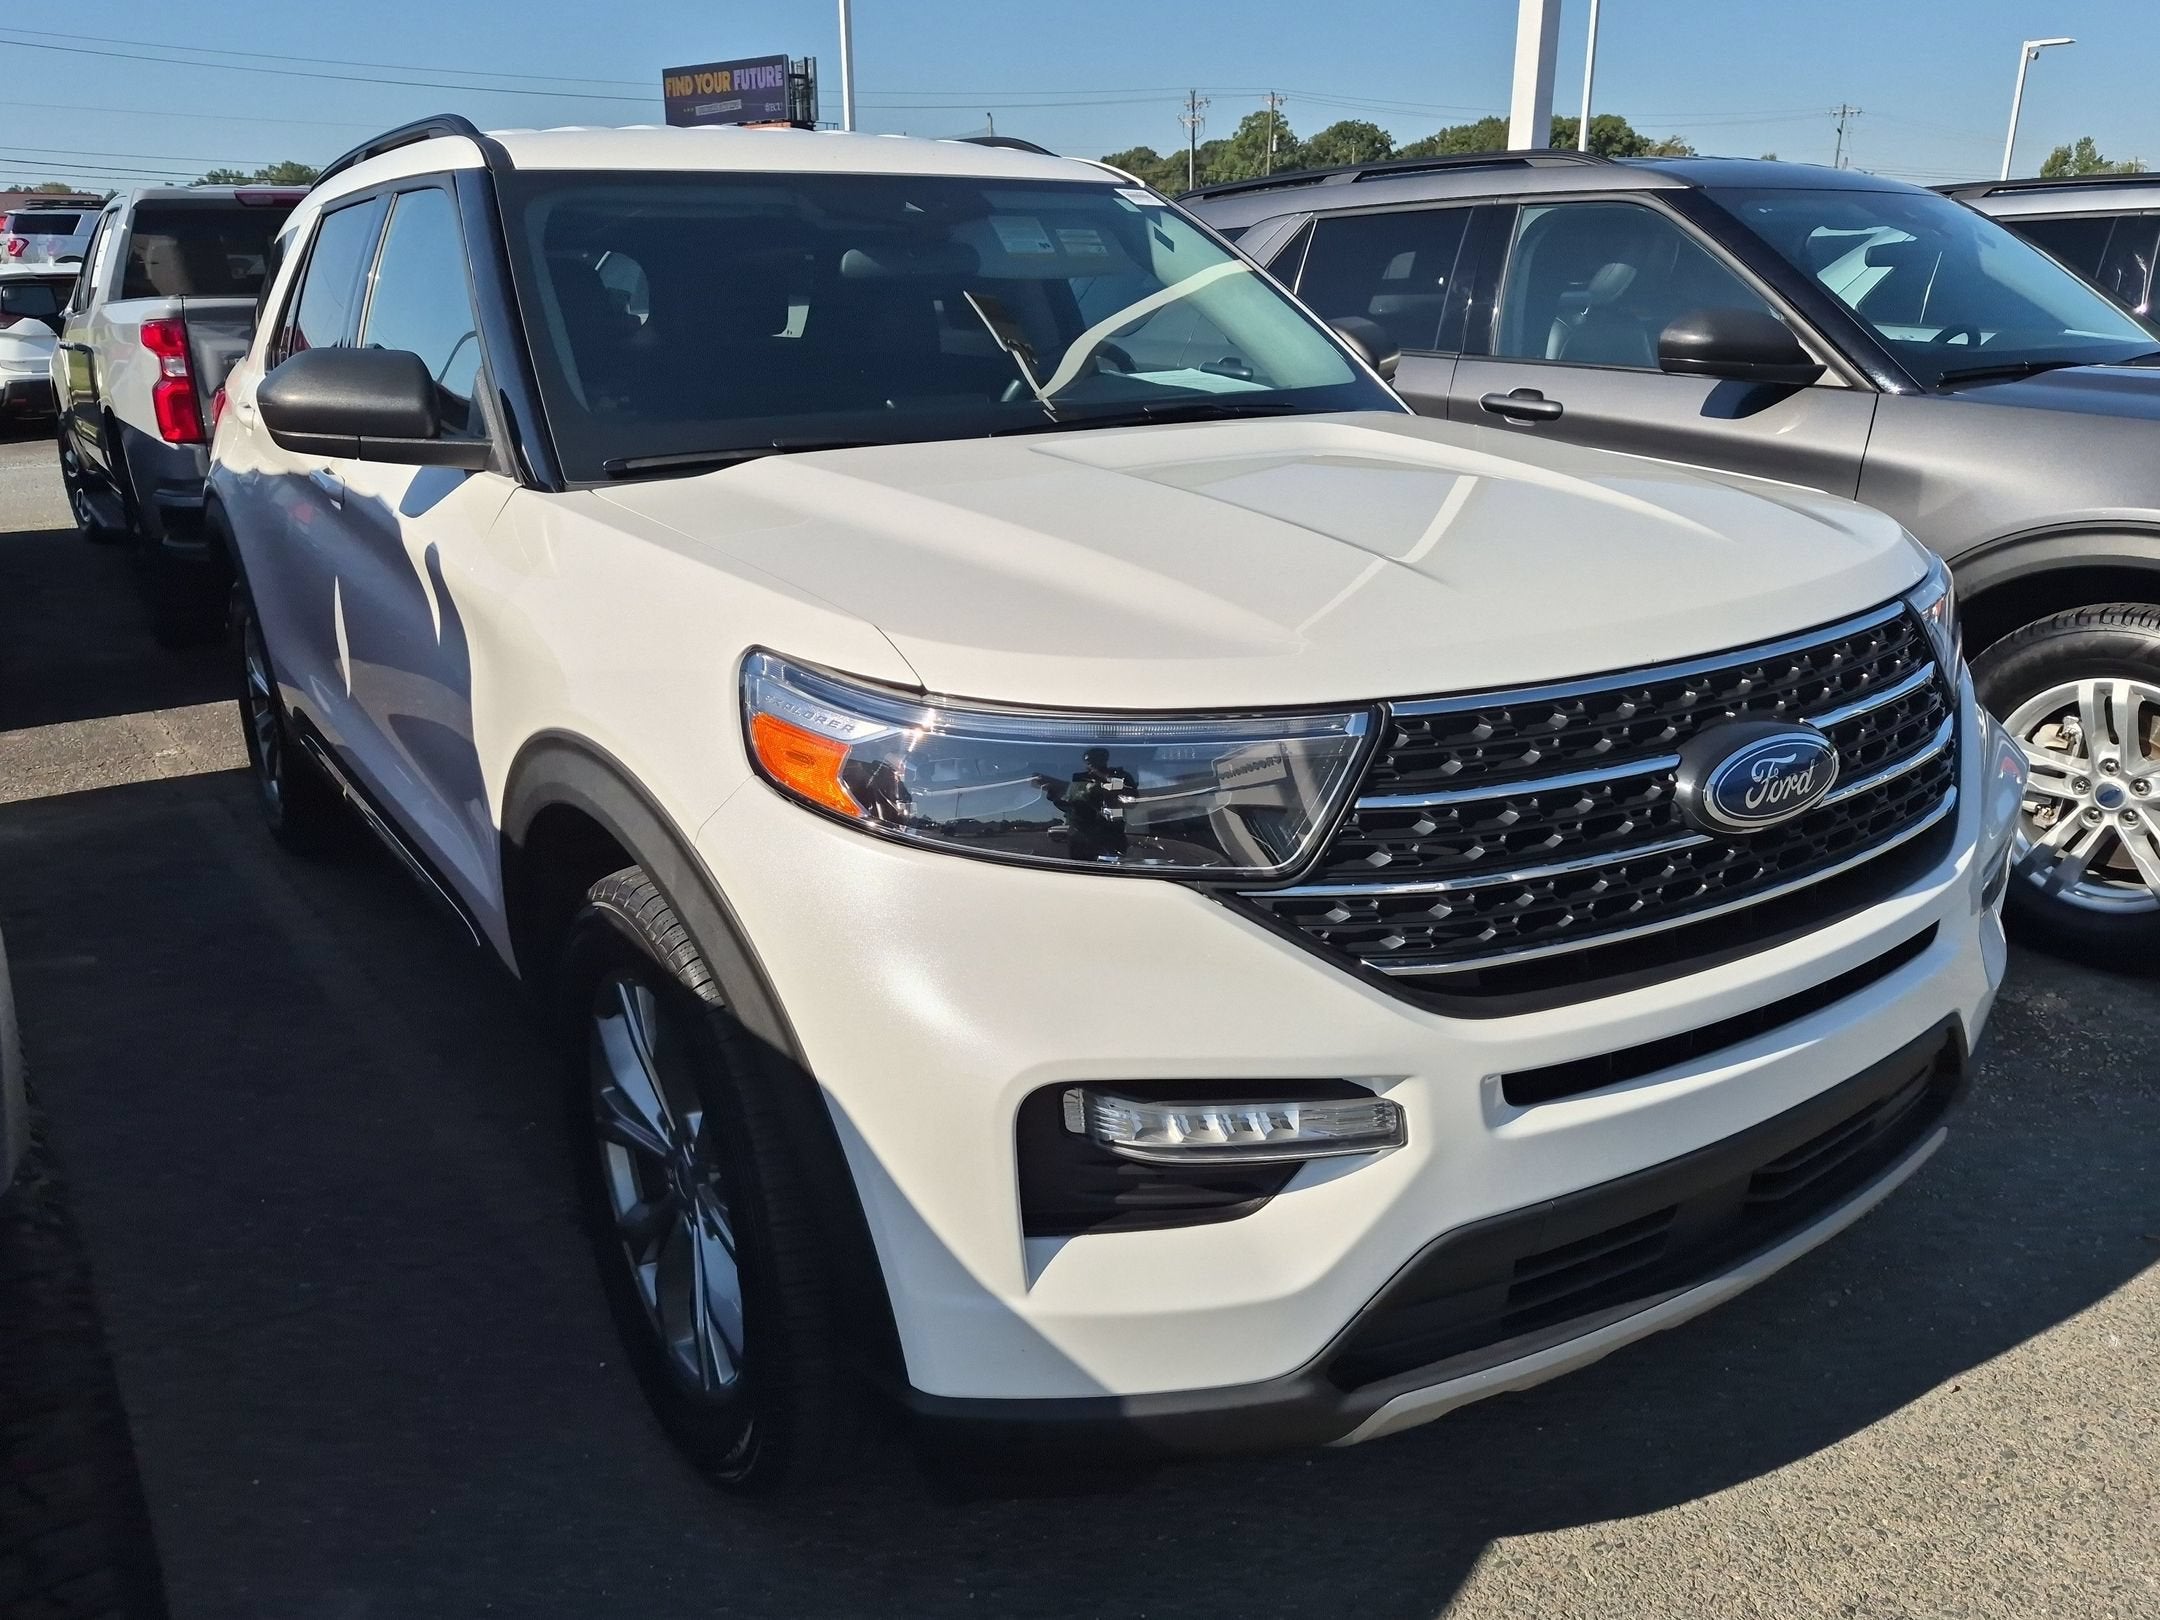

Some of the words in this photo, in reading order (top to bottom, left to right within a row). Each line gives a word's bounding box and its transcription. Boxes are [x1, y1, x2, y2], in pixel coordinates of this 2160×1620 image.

[665, 75, 693, 97] FIND
[695, 71, 731, 95] YOUR
[733, 64, 783, 91] FUTURE
[1745, 753, 1818, 809] Ford
